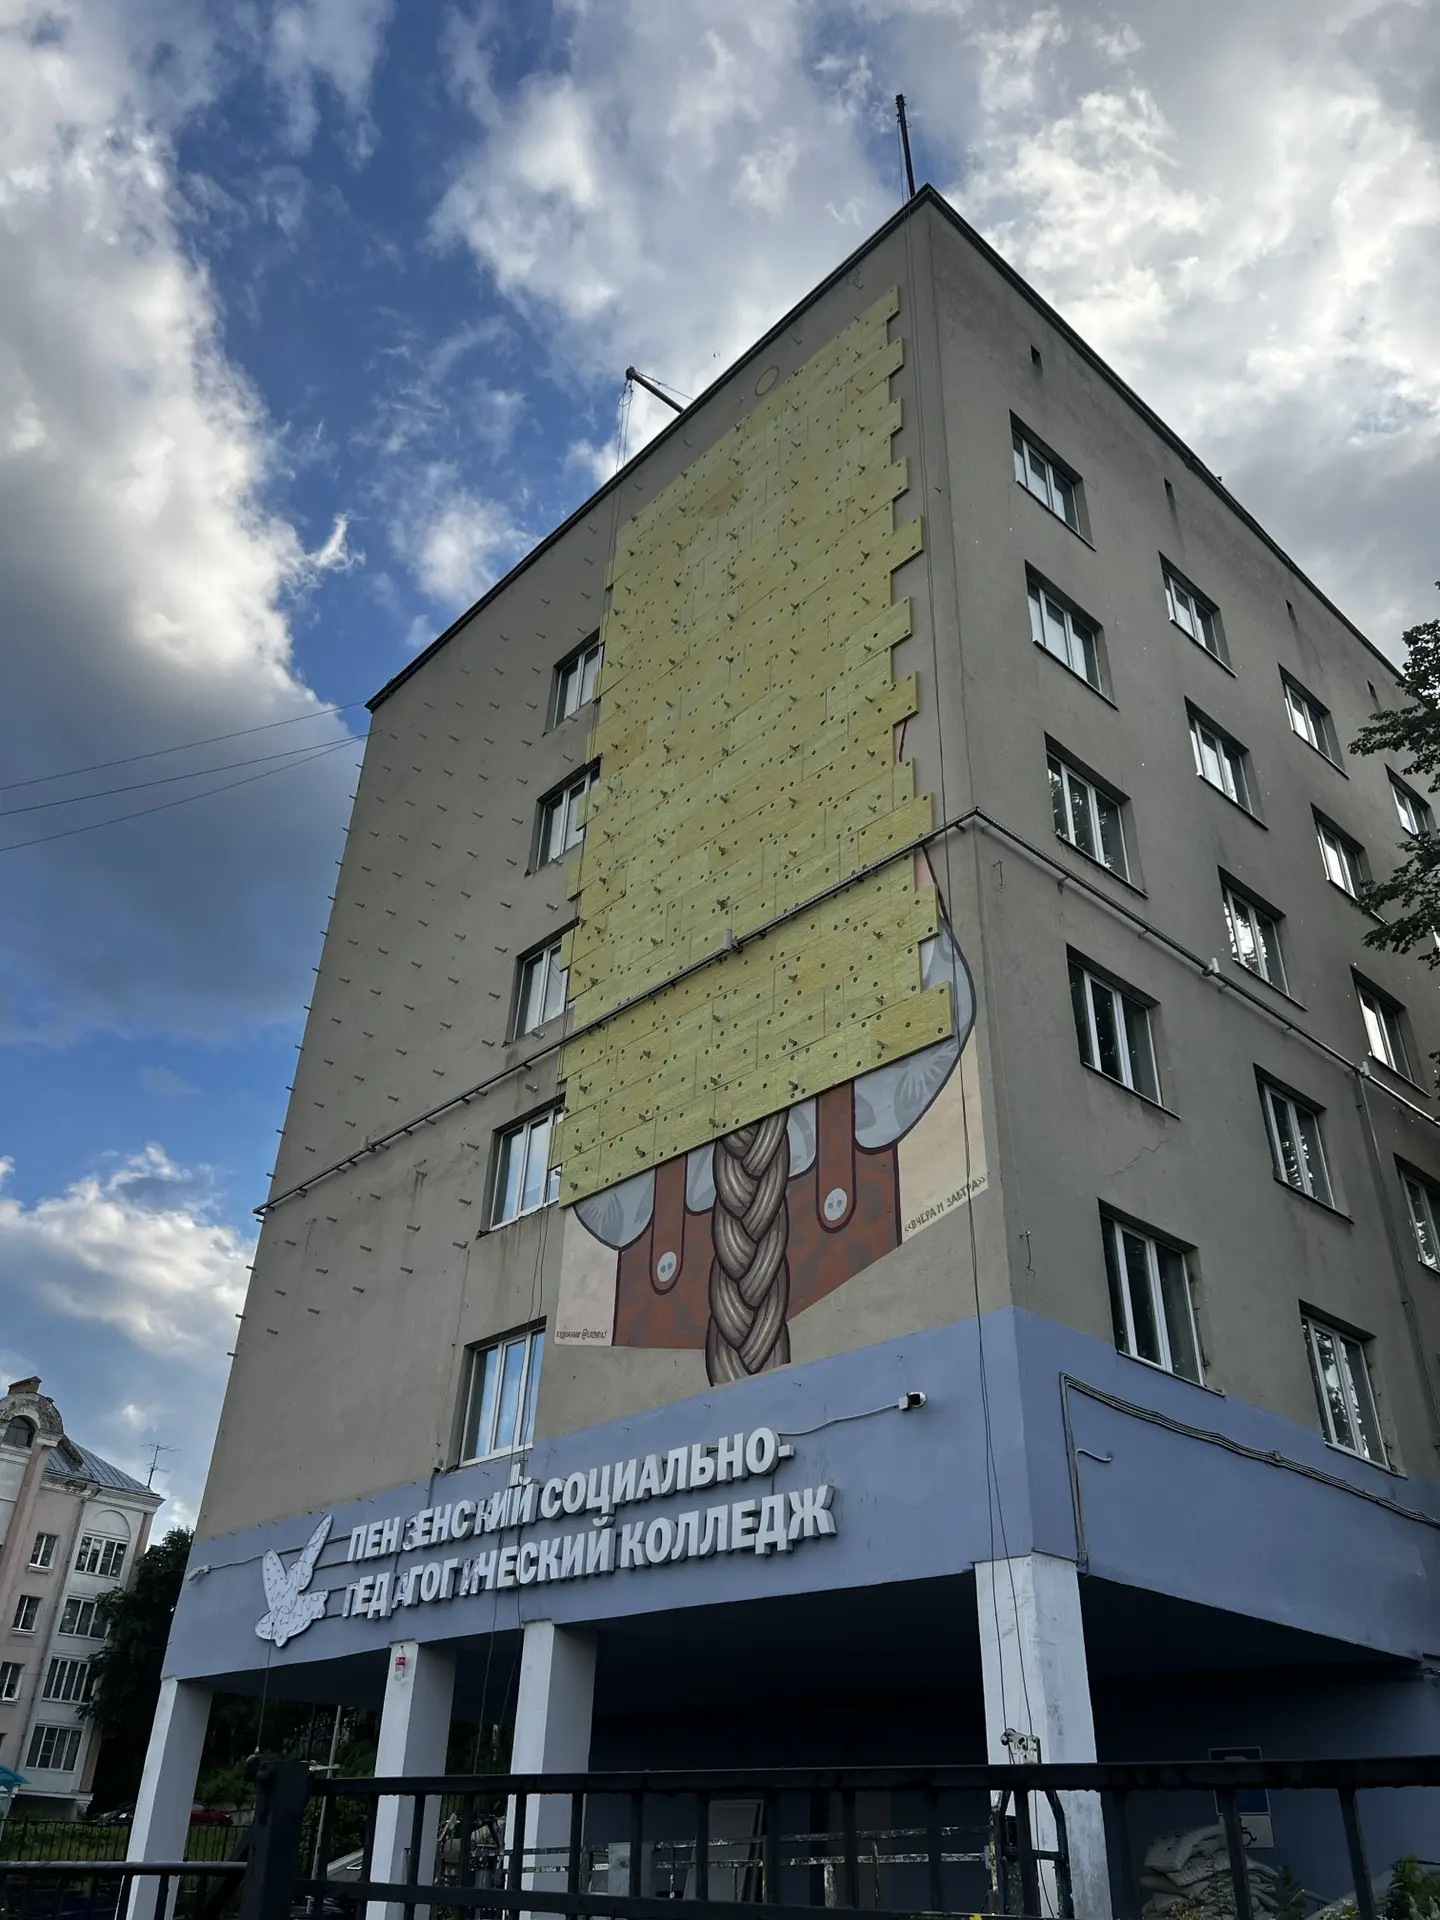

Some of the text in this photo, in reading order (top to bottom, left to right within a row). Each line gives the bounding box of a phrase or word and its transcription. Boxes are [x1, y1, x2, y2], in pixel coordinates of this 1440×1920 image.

[904, 1207, 937, 1232] «ВЧЕРА
[347, 1427, 795, 1562] ПЕНЗЕНСКИЙ СОЦИАЛЬНО-
[620, 1484, 837, 1569] КОЛЛЕДЖ
